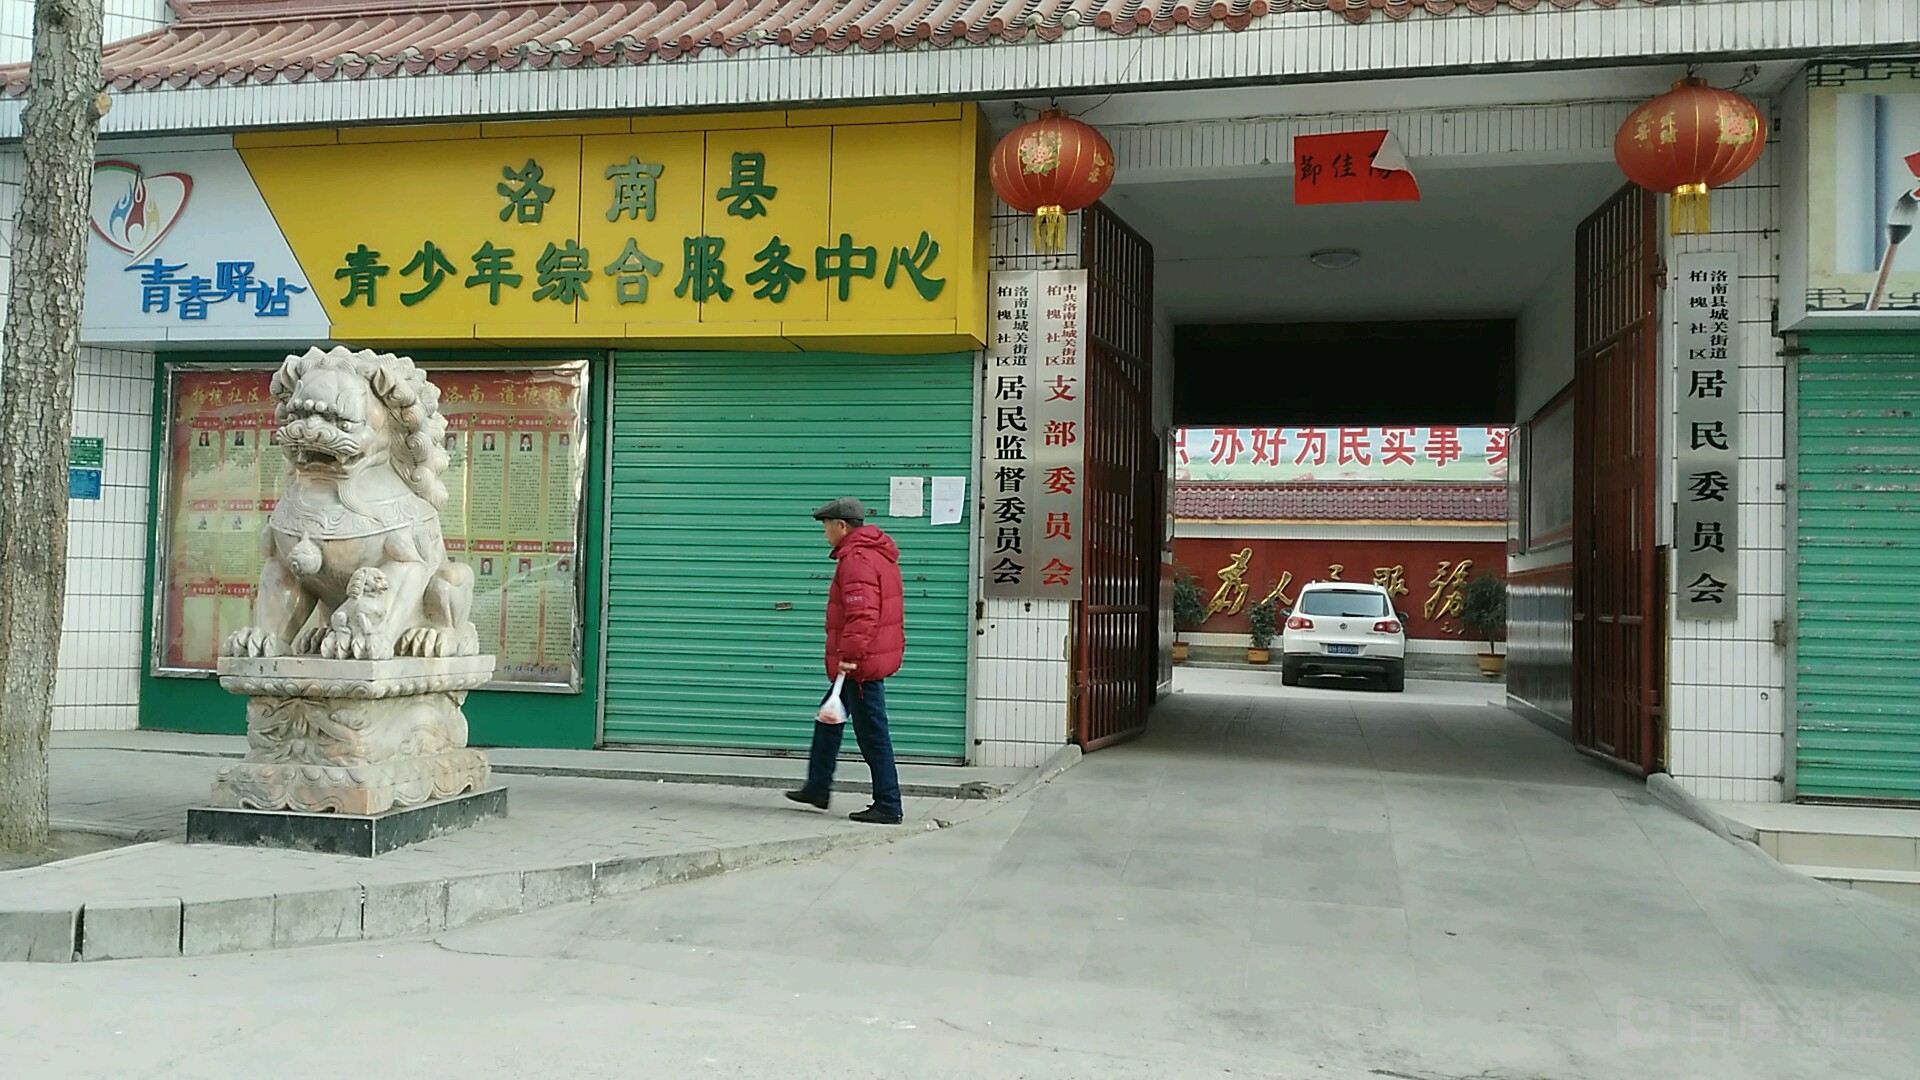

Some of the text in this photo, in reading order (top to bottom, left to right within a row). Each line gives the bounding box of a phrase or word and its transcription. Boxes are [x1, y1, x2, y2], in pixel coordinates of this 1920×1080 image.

[496, 151, 777, 225] 洛南县
[124, 258, 307, 320] 青春驿站
[333, 230, 947, 307] 青少年综合服务中心
[996, 286, 1012, 367] 柏槐社区
[1012, 286, 1029, 366] 洛南县城关街道
[1045, 285, 1061, 366] 柏槐社区
[1061, 284, 1078, 365] 中共洛南县城关街道
[1689, 270, 1708, 360] 柏槐社区
[1708, 269, 1729, 360] 洛南县城关街道
[991, 374, 1029, 585] 居民监督委员会
[1040, 374, 1078, 586] 支部委员会
[1209, 427, 1462, 466] 办好为民实事
[1687, 369, 1729, 604] 居民委员会
